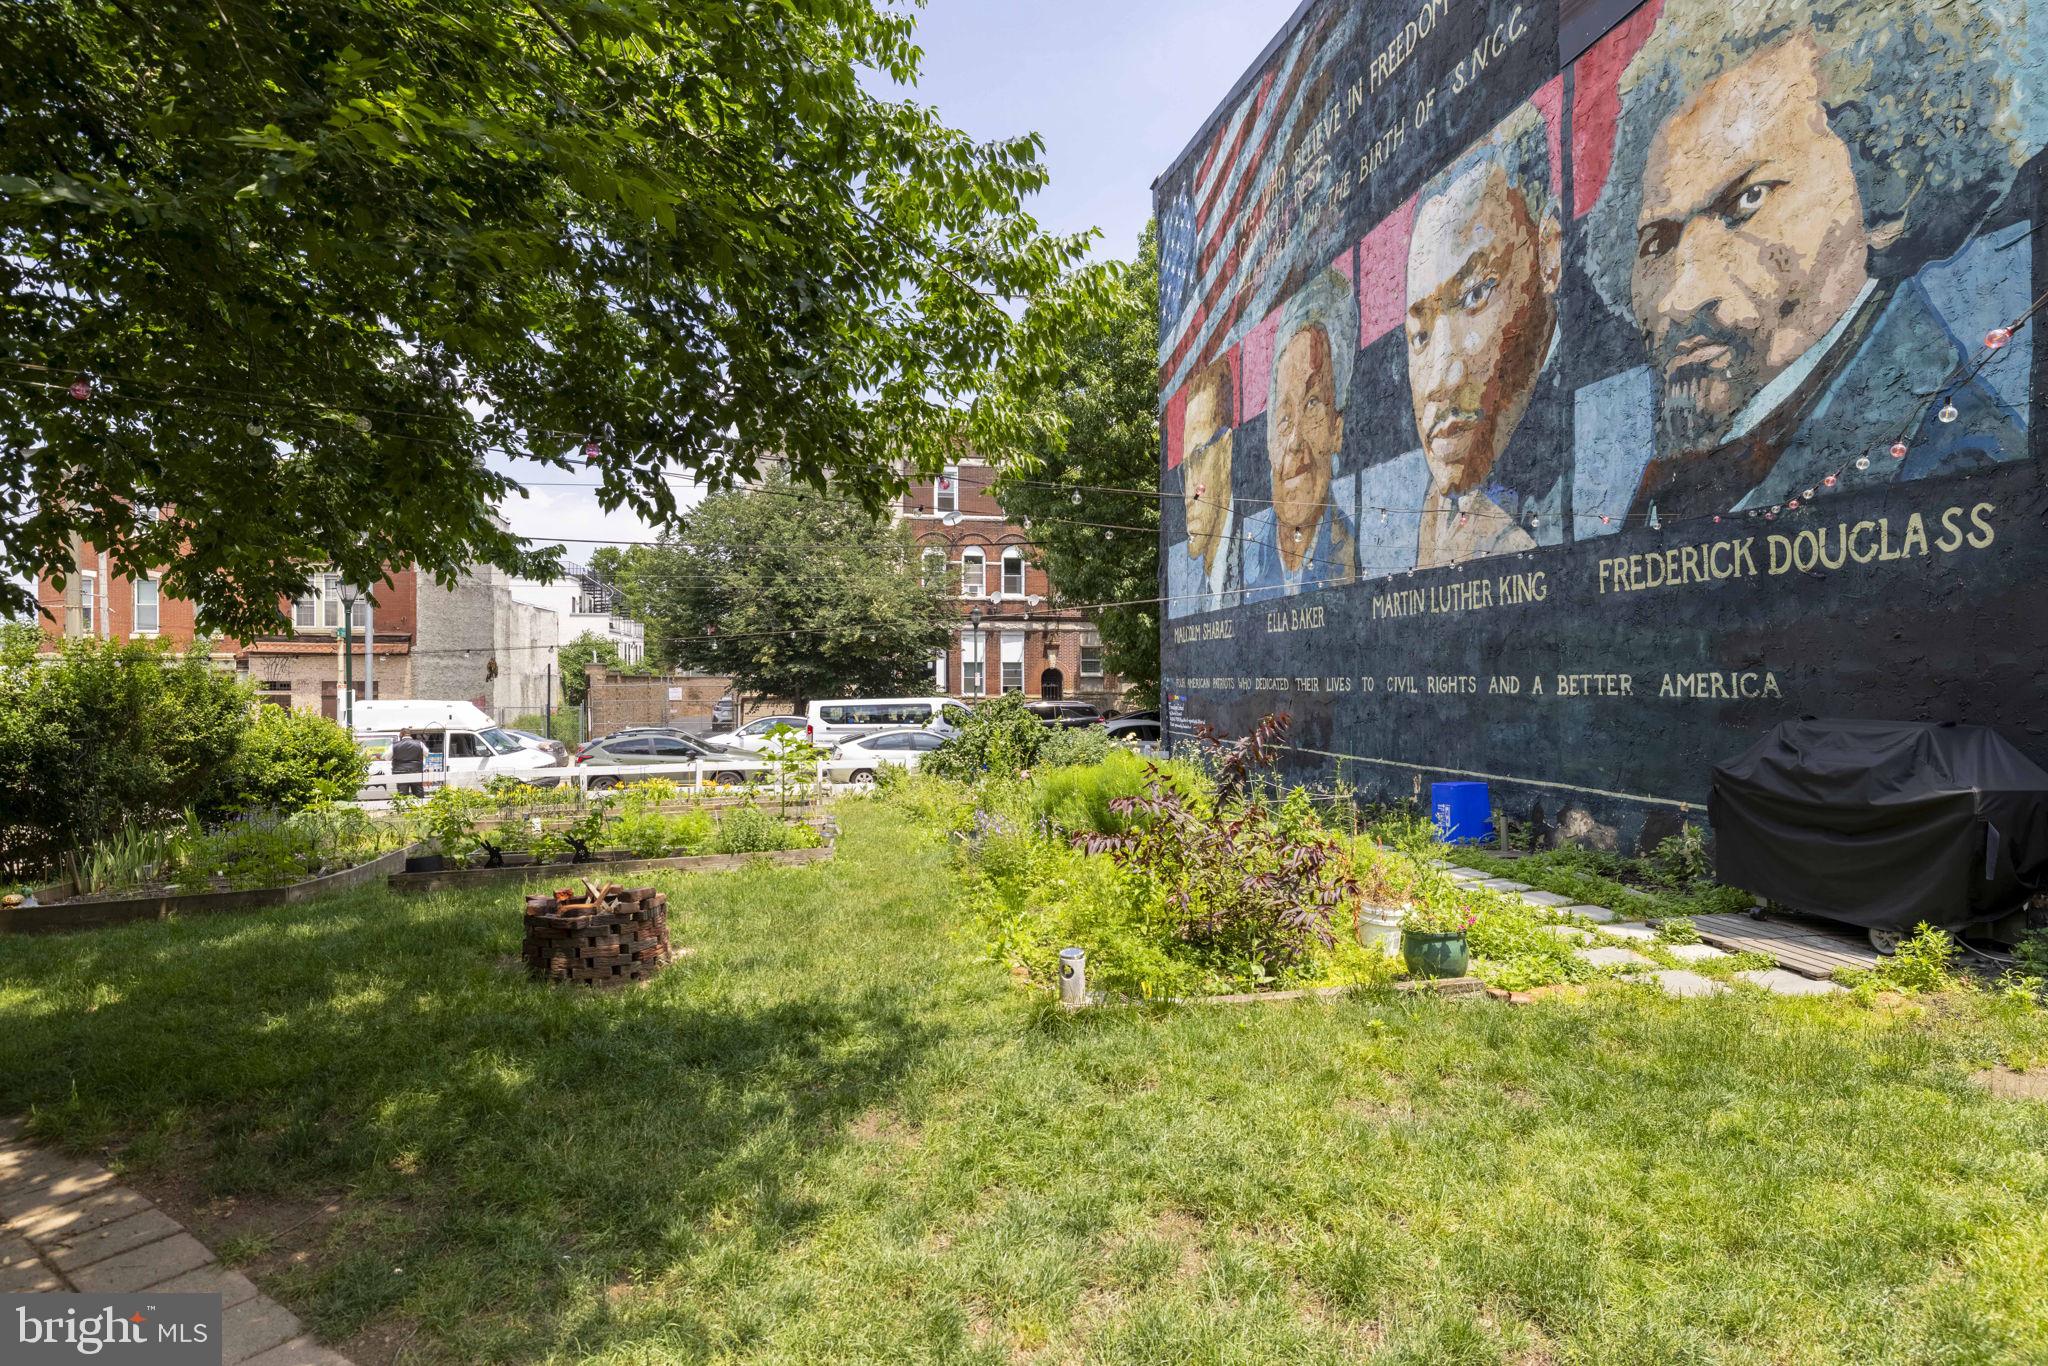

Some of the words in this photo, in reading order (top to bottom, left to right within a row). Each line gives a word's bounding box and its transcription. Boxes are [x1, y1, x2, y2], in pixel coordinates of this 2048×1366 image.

[1262, 166, 1287, 208] WHO
[1293, 101, 1341, 174] BELIEVE
[1347, 76, 1363, 119] IN
[1369, 0, 1449, 94] FREEDOM
[1327, 171, 1351, 210] THE
[1359, 116, 1406, 183] BIRTH
[1415, 88, 1436, 129] OF
[1599, 537, 1758, 594] FREDERICK
[1267, 612, 1289, 632] ELLA
[1291, 606, 1326, 631] BAKER
[1372, 588, 1425, 619] MARTIN
[1430, 579, 1492, 614] LUTHER
[1499, 571, 1548, 606] KING
[1203, 619, 1233, 640] SHABAZZ
[1255, 677, 1290, 691] DEDICATED
[1295, 677, 1320, 692] THEIR
[1326, 677, 1351, 692] LIVES
[1361, 677, 1374, 693] TO
[1386, 676, 1418, 694] CIVIL
[1427, 676, 1477, 694] RIGHTS
[1488, 675, 1520, 695] AND
[1532, 675, 1544, 695] A
[1557, 672, 1633, 696] BETTER
[1658, 671, 1783, 699] AMERICA
